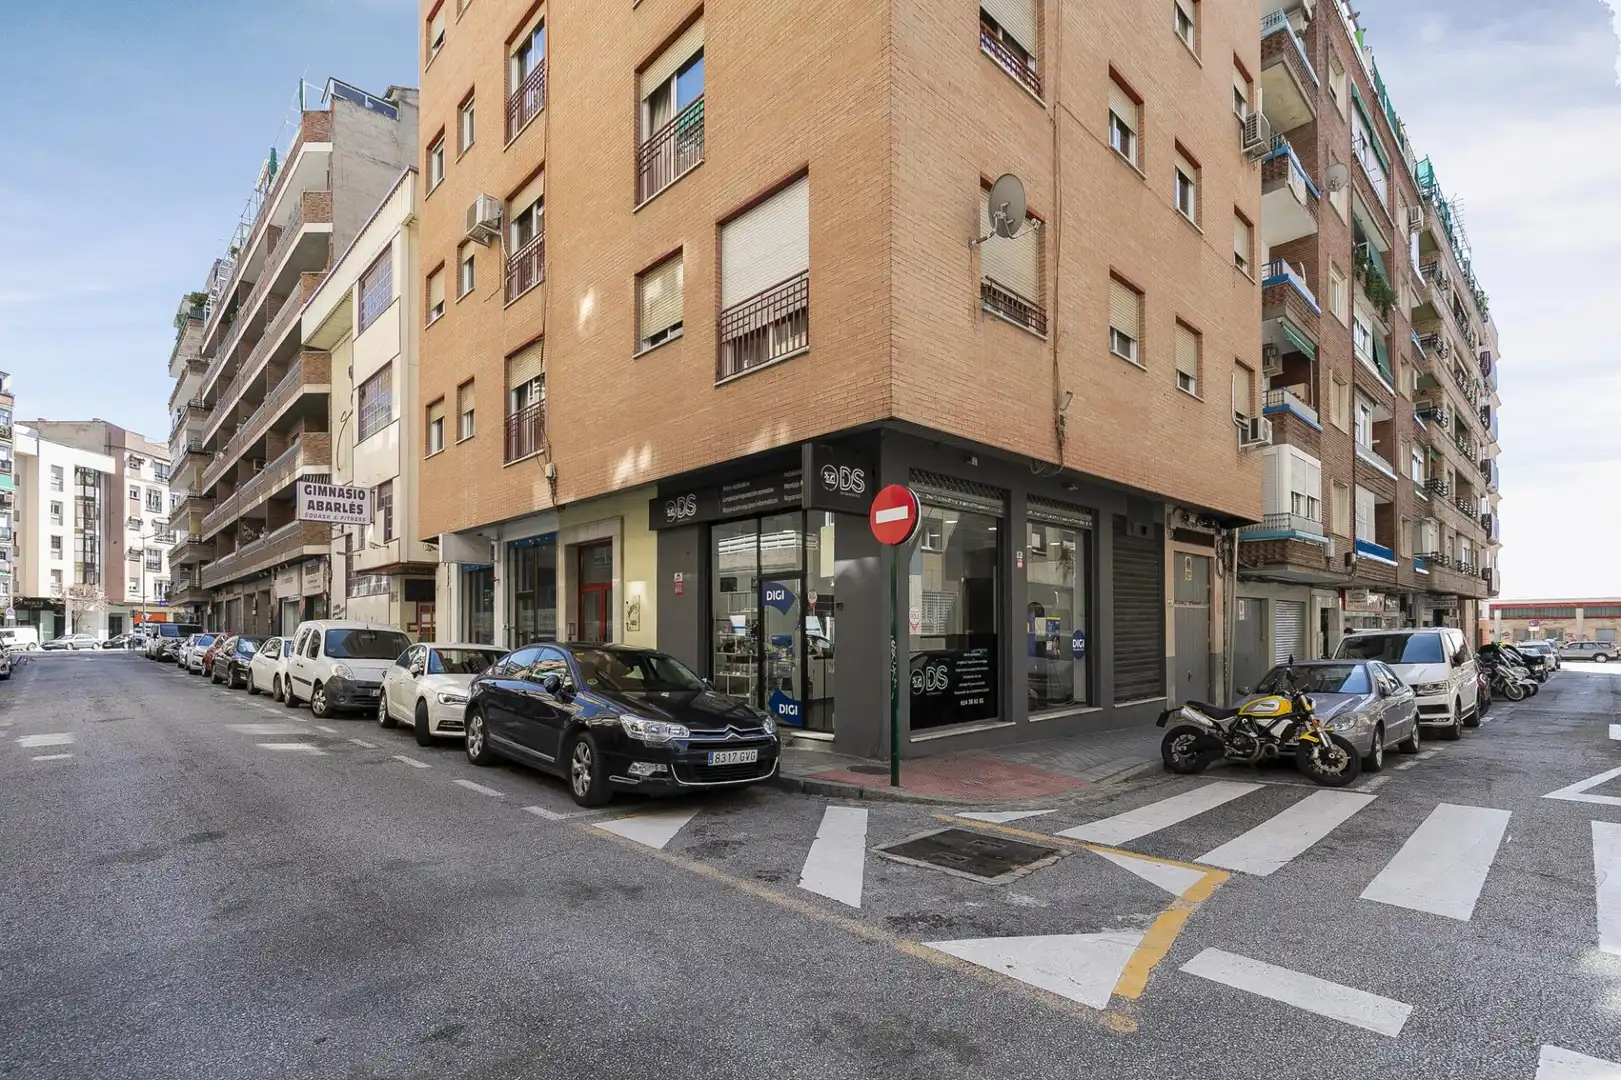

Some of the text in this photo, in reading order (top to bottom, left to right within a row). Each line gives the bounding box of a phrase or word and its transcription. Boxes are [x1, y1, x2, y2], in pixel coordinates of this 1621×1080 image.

[839, 465, 865, 493] DS
[304, 484, 366, 500] GIMNASIO
[307, 500, 364, 515] ABARLÉS
[676, 493, 697, 518] DS
[304, 512, 331, 520] SQUASH
[766, 590, 785, 601] DIGI
[1072, 639, 1085, 648] DIGI
[925, 665, 949, 691] DS
[778, 704, 798, 715] DIGI
[715, 752, 737, 763] 8317
